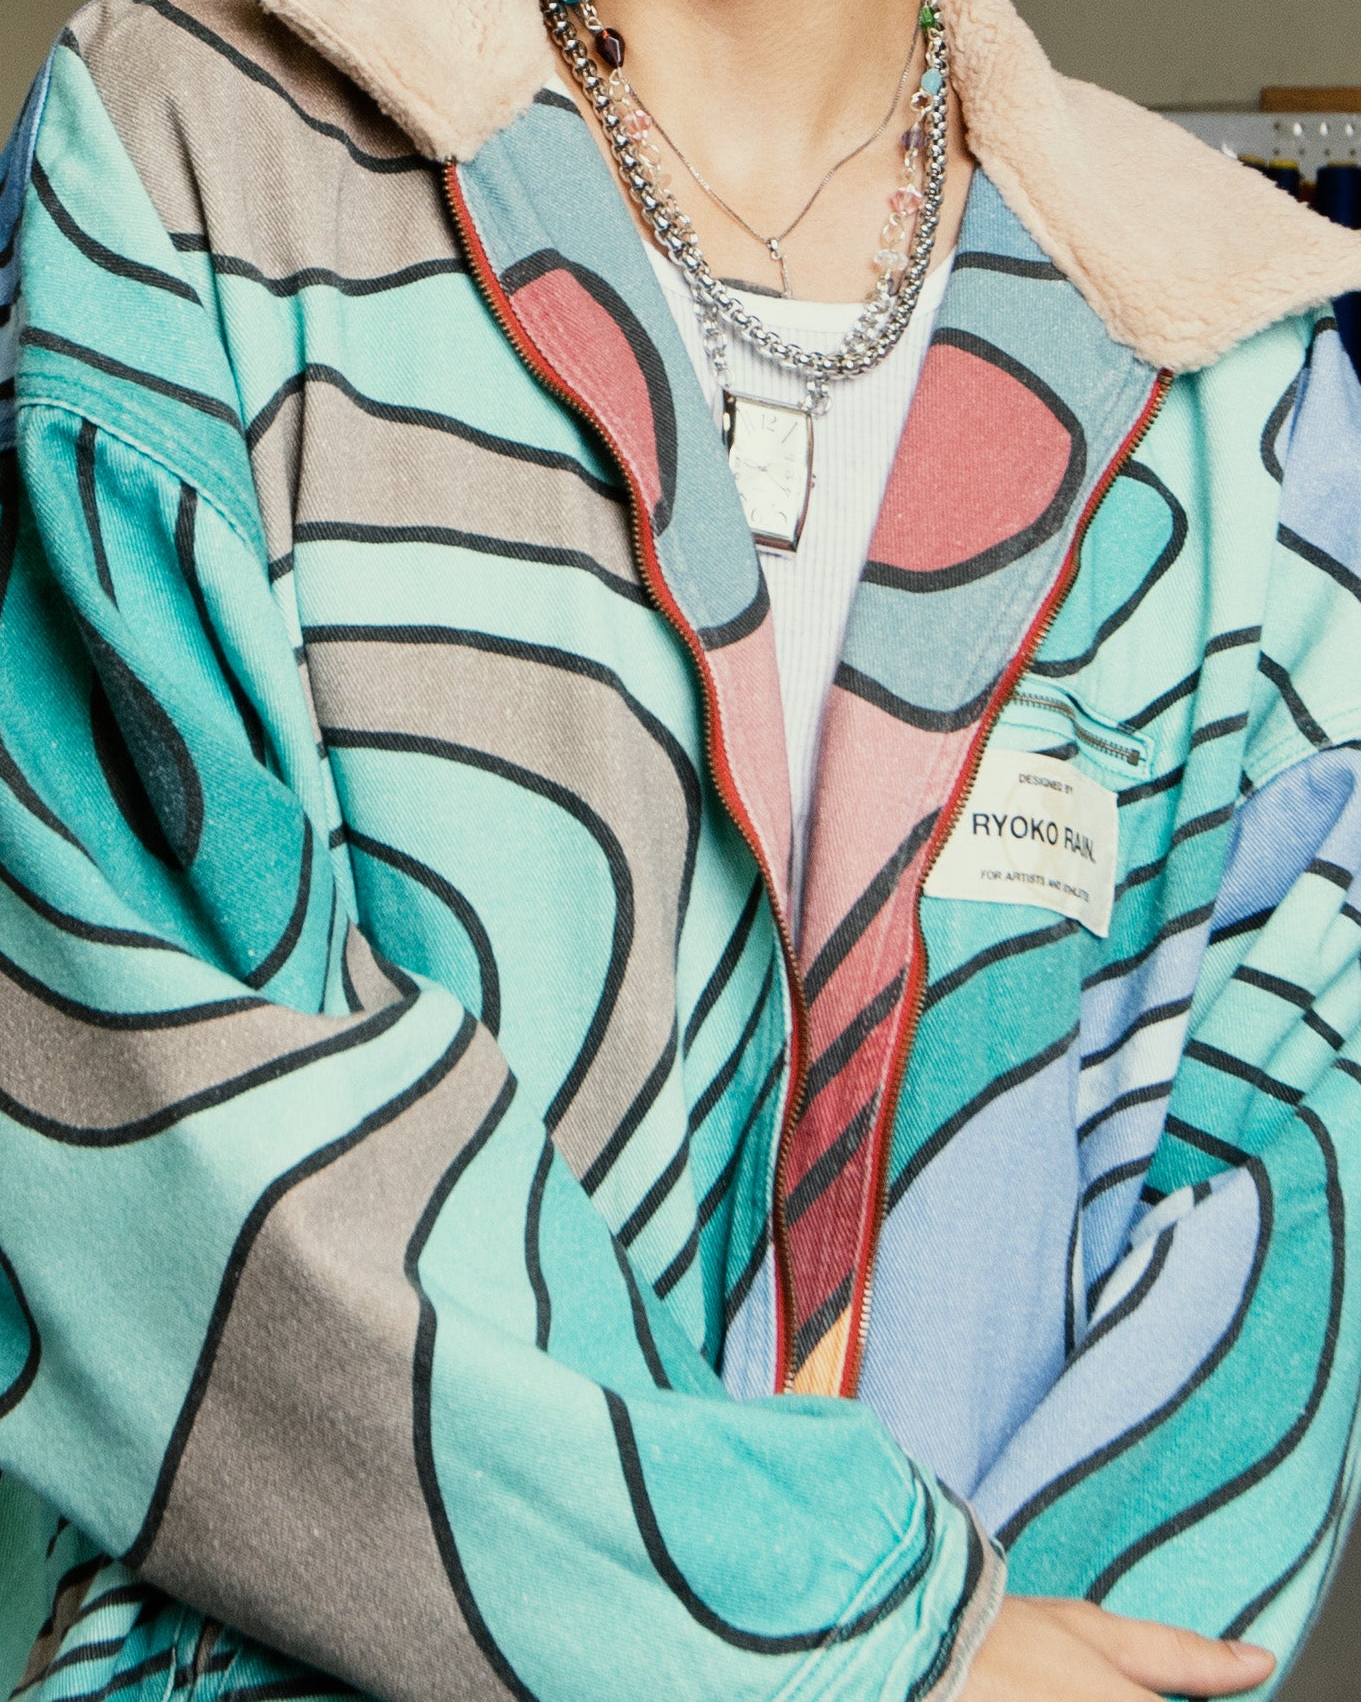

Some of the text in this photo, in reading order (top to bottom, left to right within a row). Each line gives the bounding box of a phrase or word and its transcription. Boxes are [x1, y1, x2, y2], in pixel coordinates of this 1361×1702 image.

[1019, 773, 1063, 792] DESIGNED
[972, 812, 1059, 846] RYOKO
[980, 869, 1002, 880] FOR
[1005, 871, 1046, 886] ARTISTS
